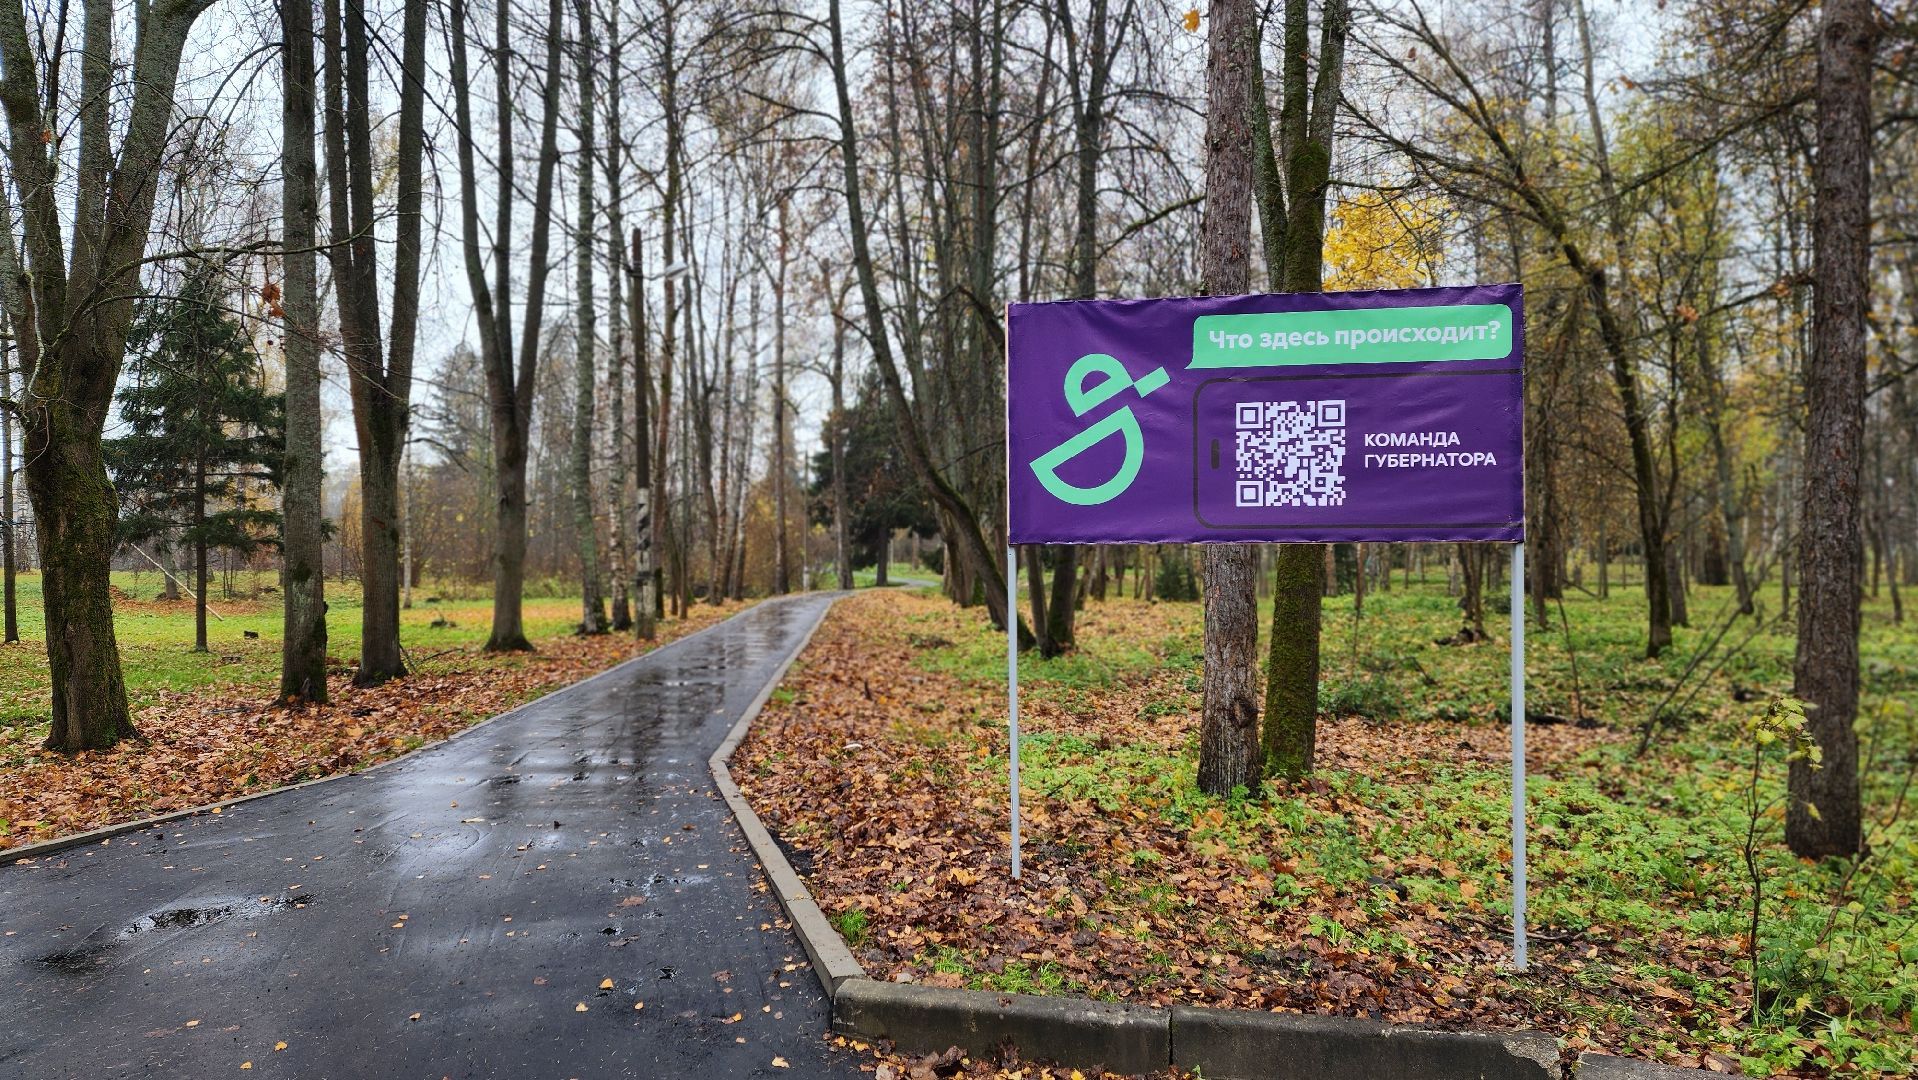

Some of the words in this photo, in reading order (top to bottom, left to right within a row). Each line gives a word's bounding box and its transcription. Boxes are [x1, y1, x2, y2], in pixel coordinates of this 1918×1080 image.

[1209, 330, 1253, 349] Что
[1260, 329, 1329, 350] здесь
[1335, 320, 1500, 349] происходит?
[1364, 431, 1460, 447] КОМАНДА
[1364, 452, 1497, 468] ГУБЕРНАТОРА
